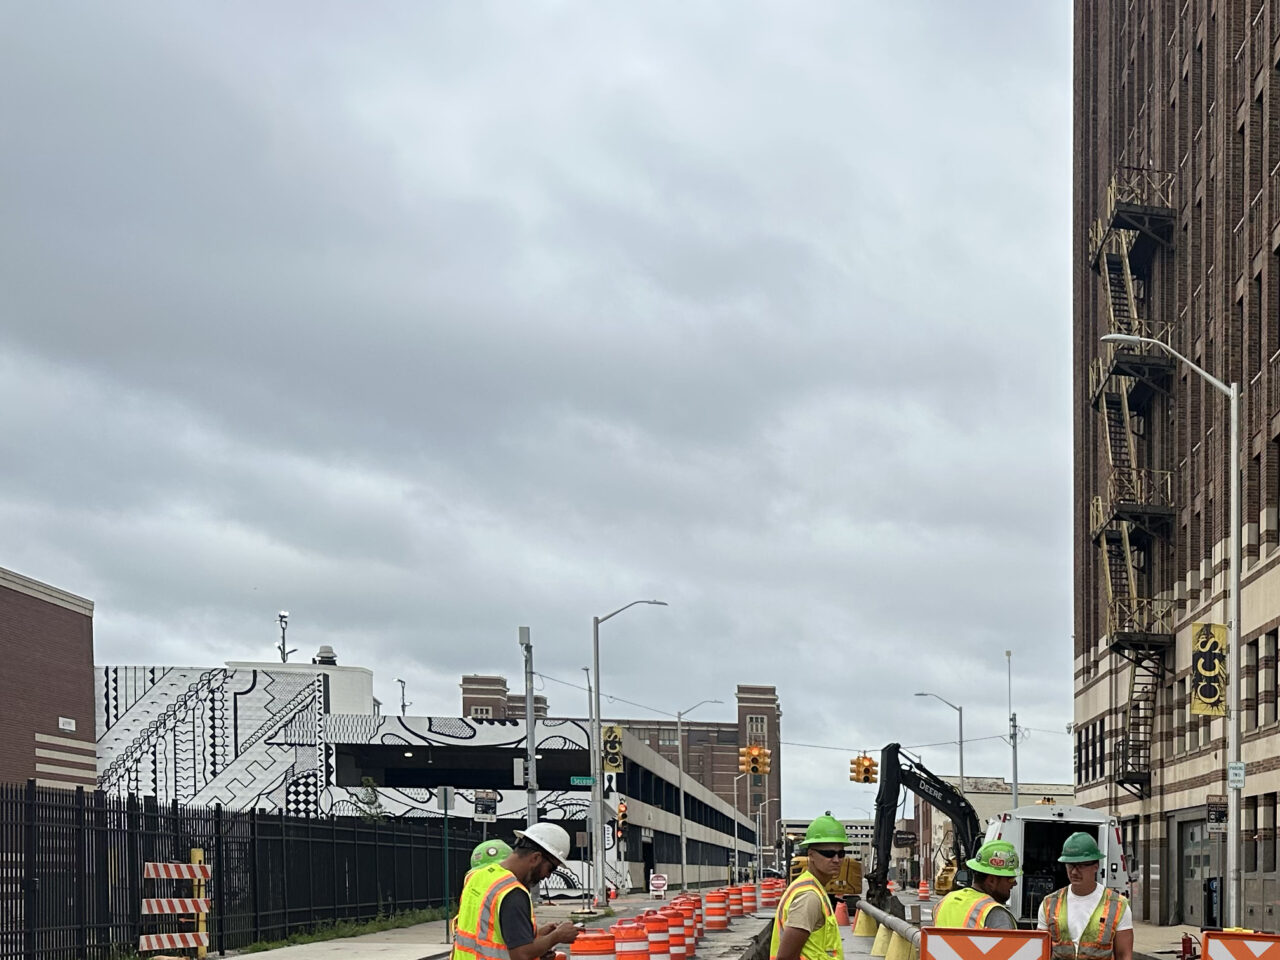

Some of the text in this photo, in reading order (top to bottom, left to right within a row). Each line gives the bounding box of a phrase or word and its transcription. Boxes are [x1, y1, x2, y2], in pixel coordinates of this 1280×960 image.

[1197, 636, 1221, 704] CCS
[606, 733, 620, 766] CCS
[919, 779, 943, 801] DEERE
